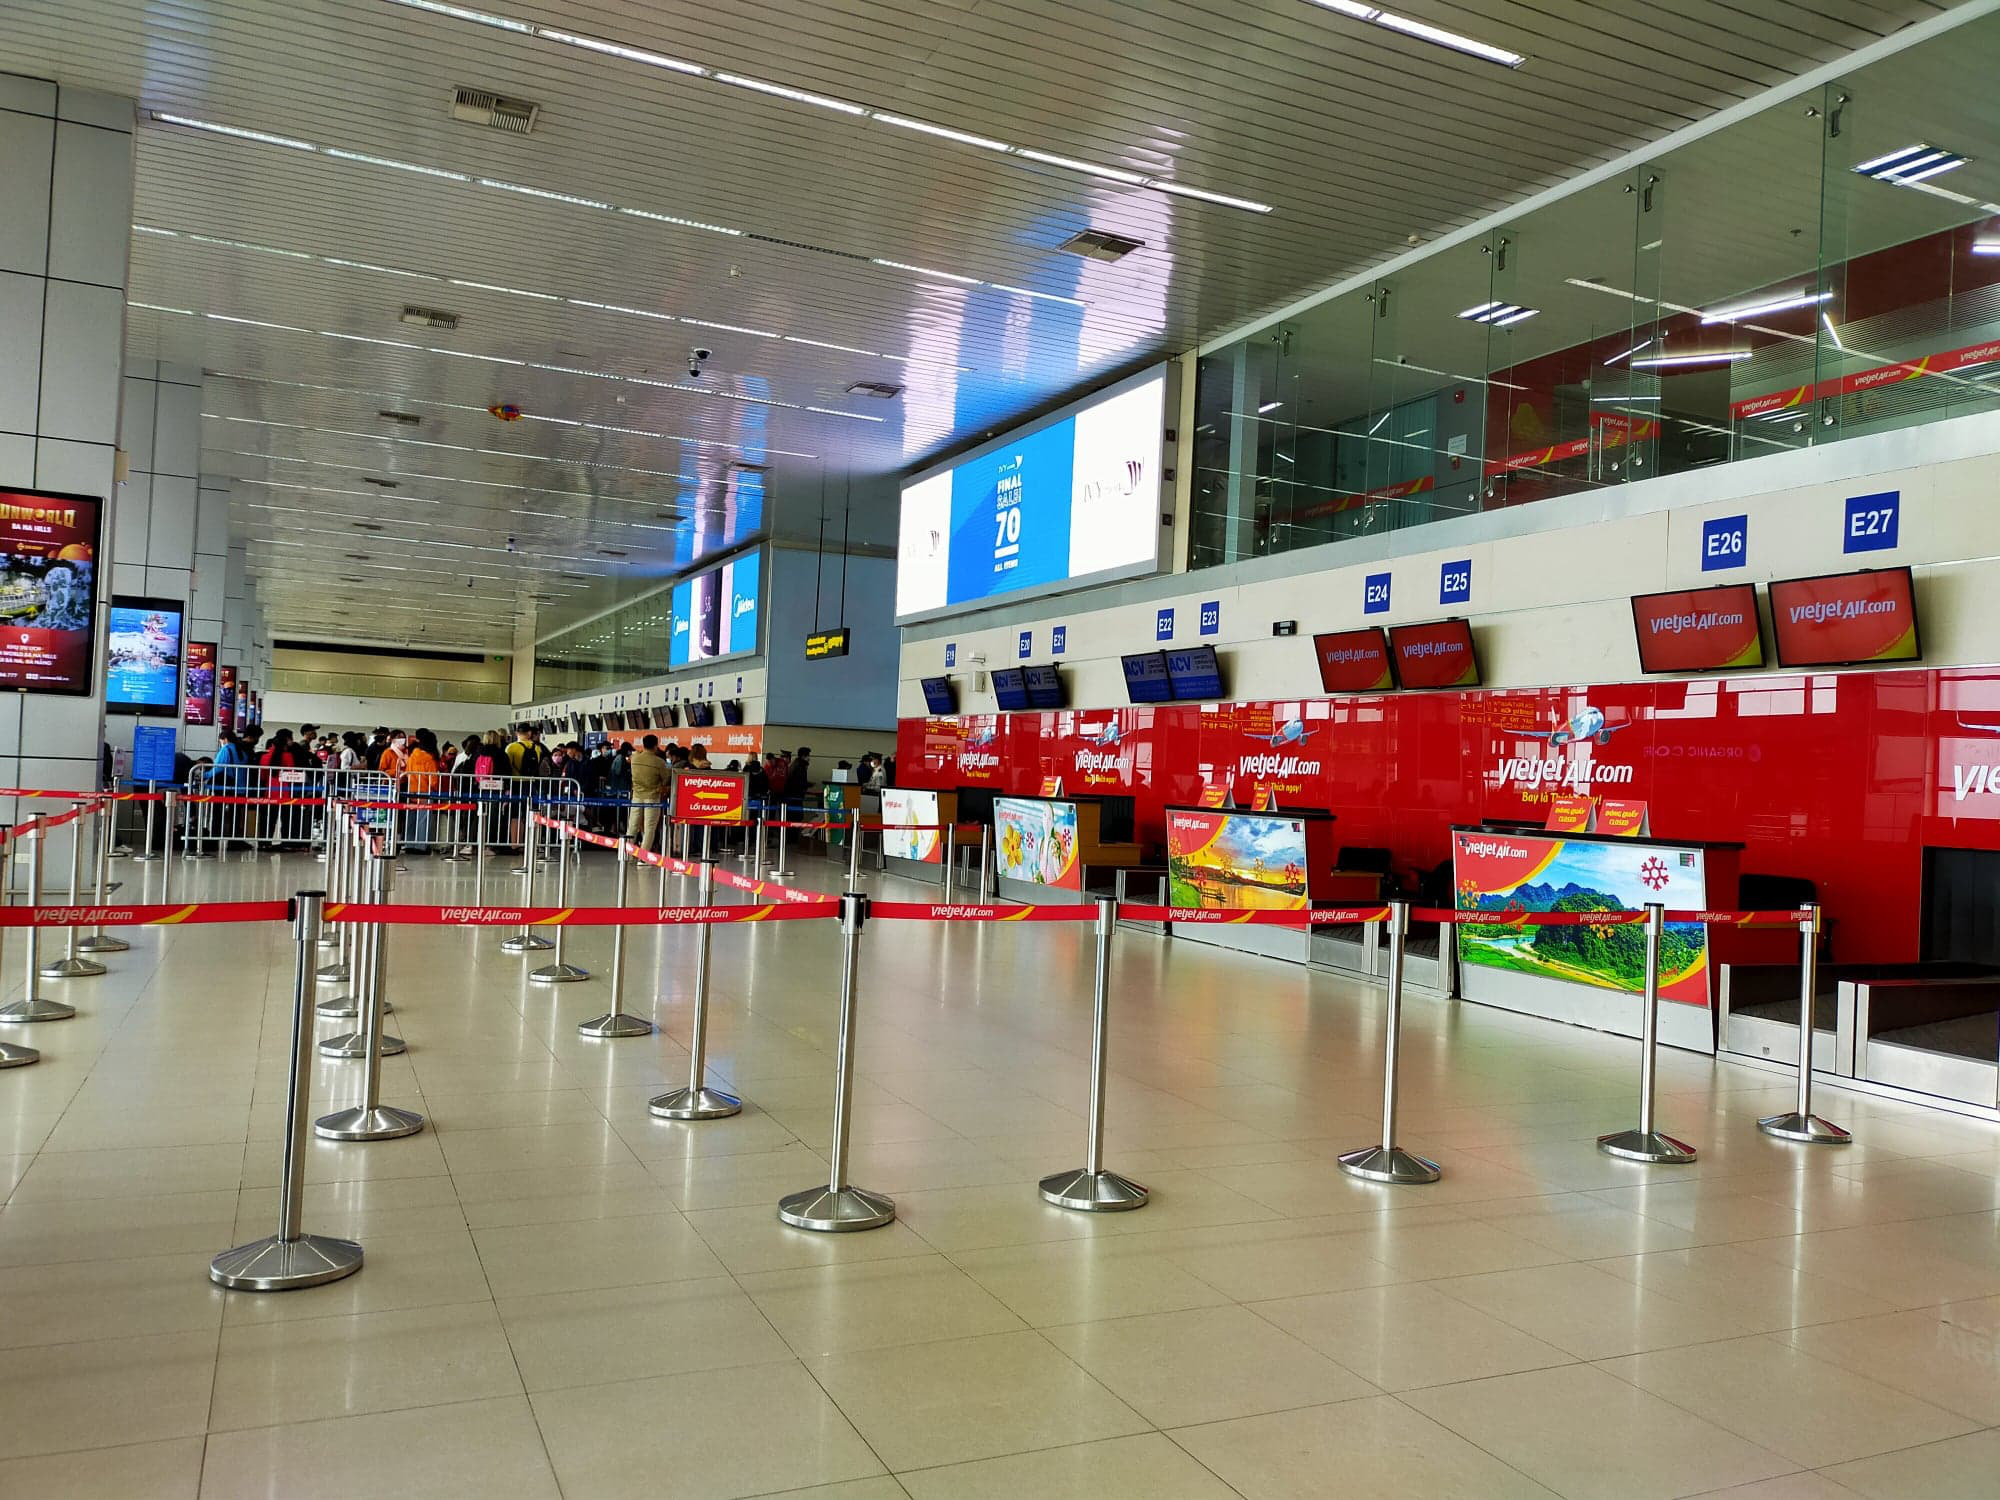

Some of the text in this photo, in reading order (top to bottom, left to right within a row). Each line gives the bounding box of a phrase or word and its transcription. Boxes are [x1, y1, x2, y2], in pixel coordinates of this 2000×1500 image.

[997, 472, 1022, 495] FINAL
[995, 506, 1021, 547] 70
[1850, 508, 1893, 537] E27
[1707, 529, 1742, 557] E26
[1443, 571, 1468, 594] E25
[1367, 584, 1388, 604] E24
[1158, 617, 1173, 632] E22
[1202, 610, 1217, 626] E23
[1020, 638, 1030, 651] E20
[1053, 632, 1064, 646] E21
[1125, 660, 1144, 677] ACV
[1168, 655, 1191, 673] ACV
[1522, 791, 1539, 805] Bay
